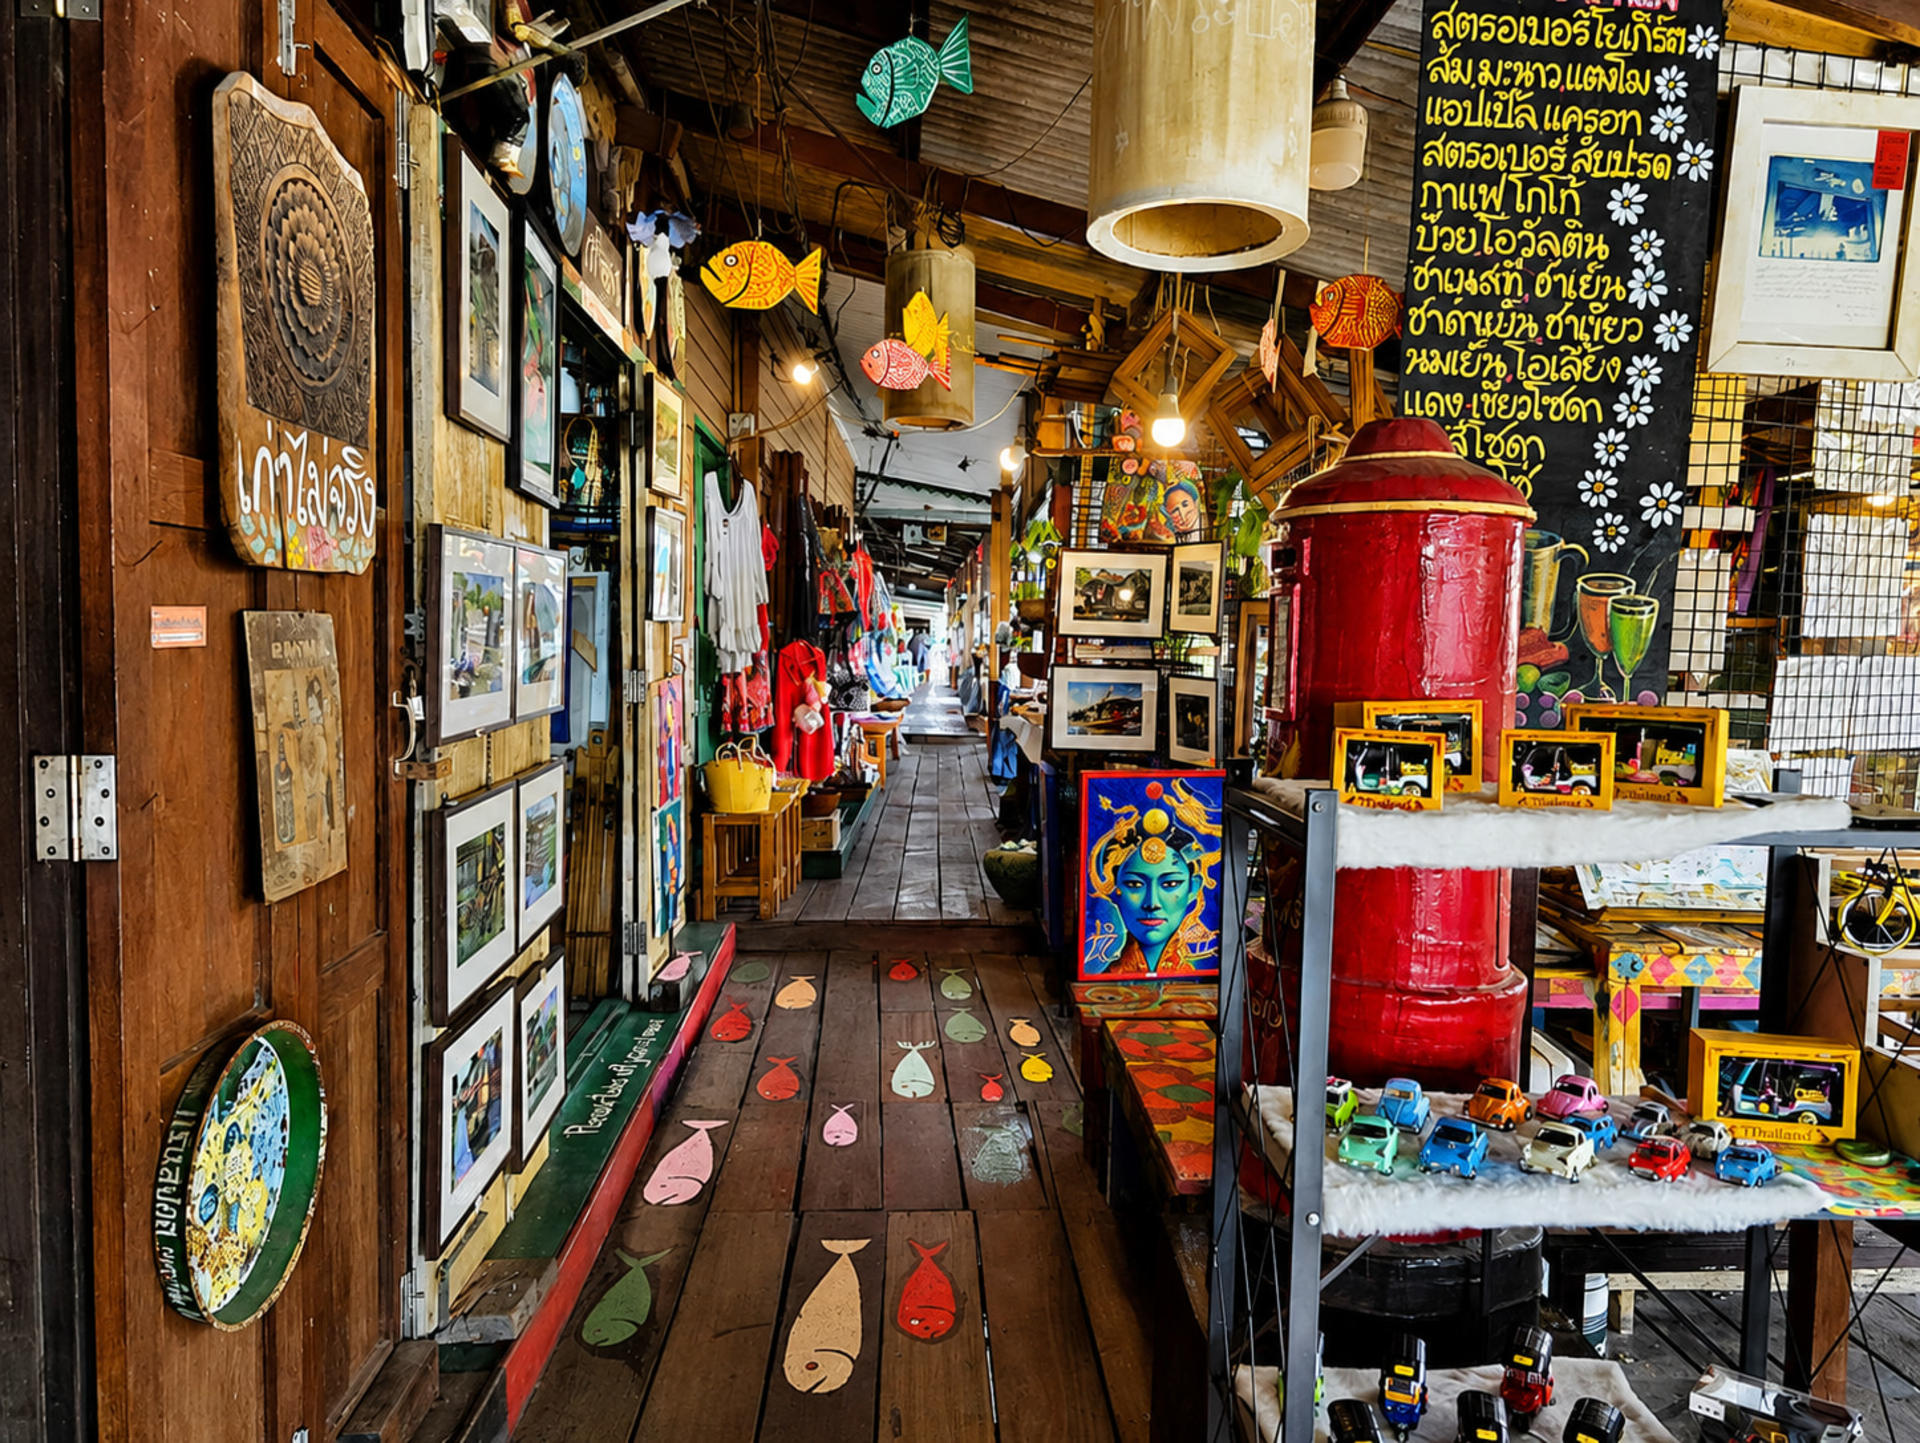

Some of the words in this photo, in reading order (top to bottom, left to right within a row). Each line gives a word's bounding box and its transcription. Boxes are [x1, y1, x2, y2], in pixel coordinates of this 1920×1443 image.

[1544, 104, 1643, 137] แครอท
[1419, 173, 1507, 212] กาแฟ
[1508, 173, 1586, 216] โกโก้
[237, 419, 377, 539] เก่าไม่จริง
